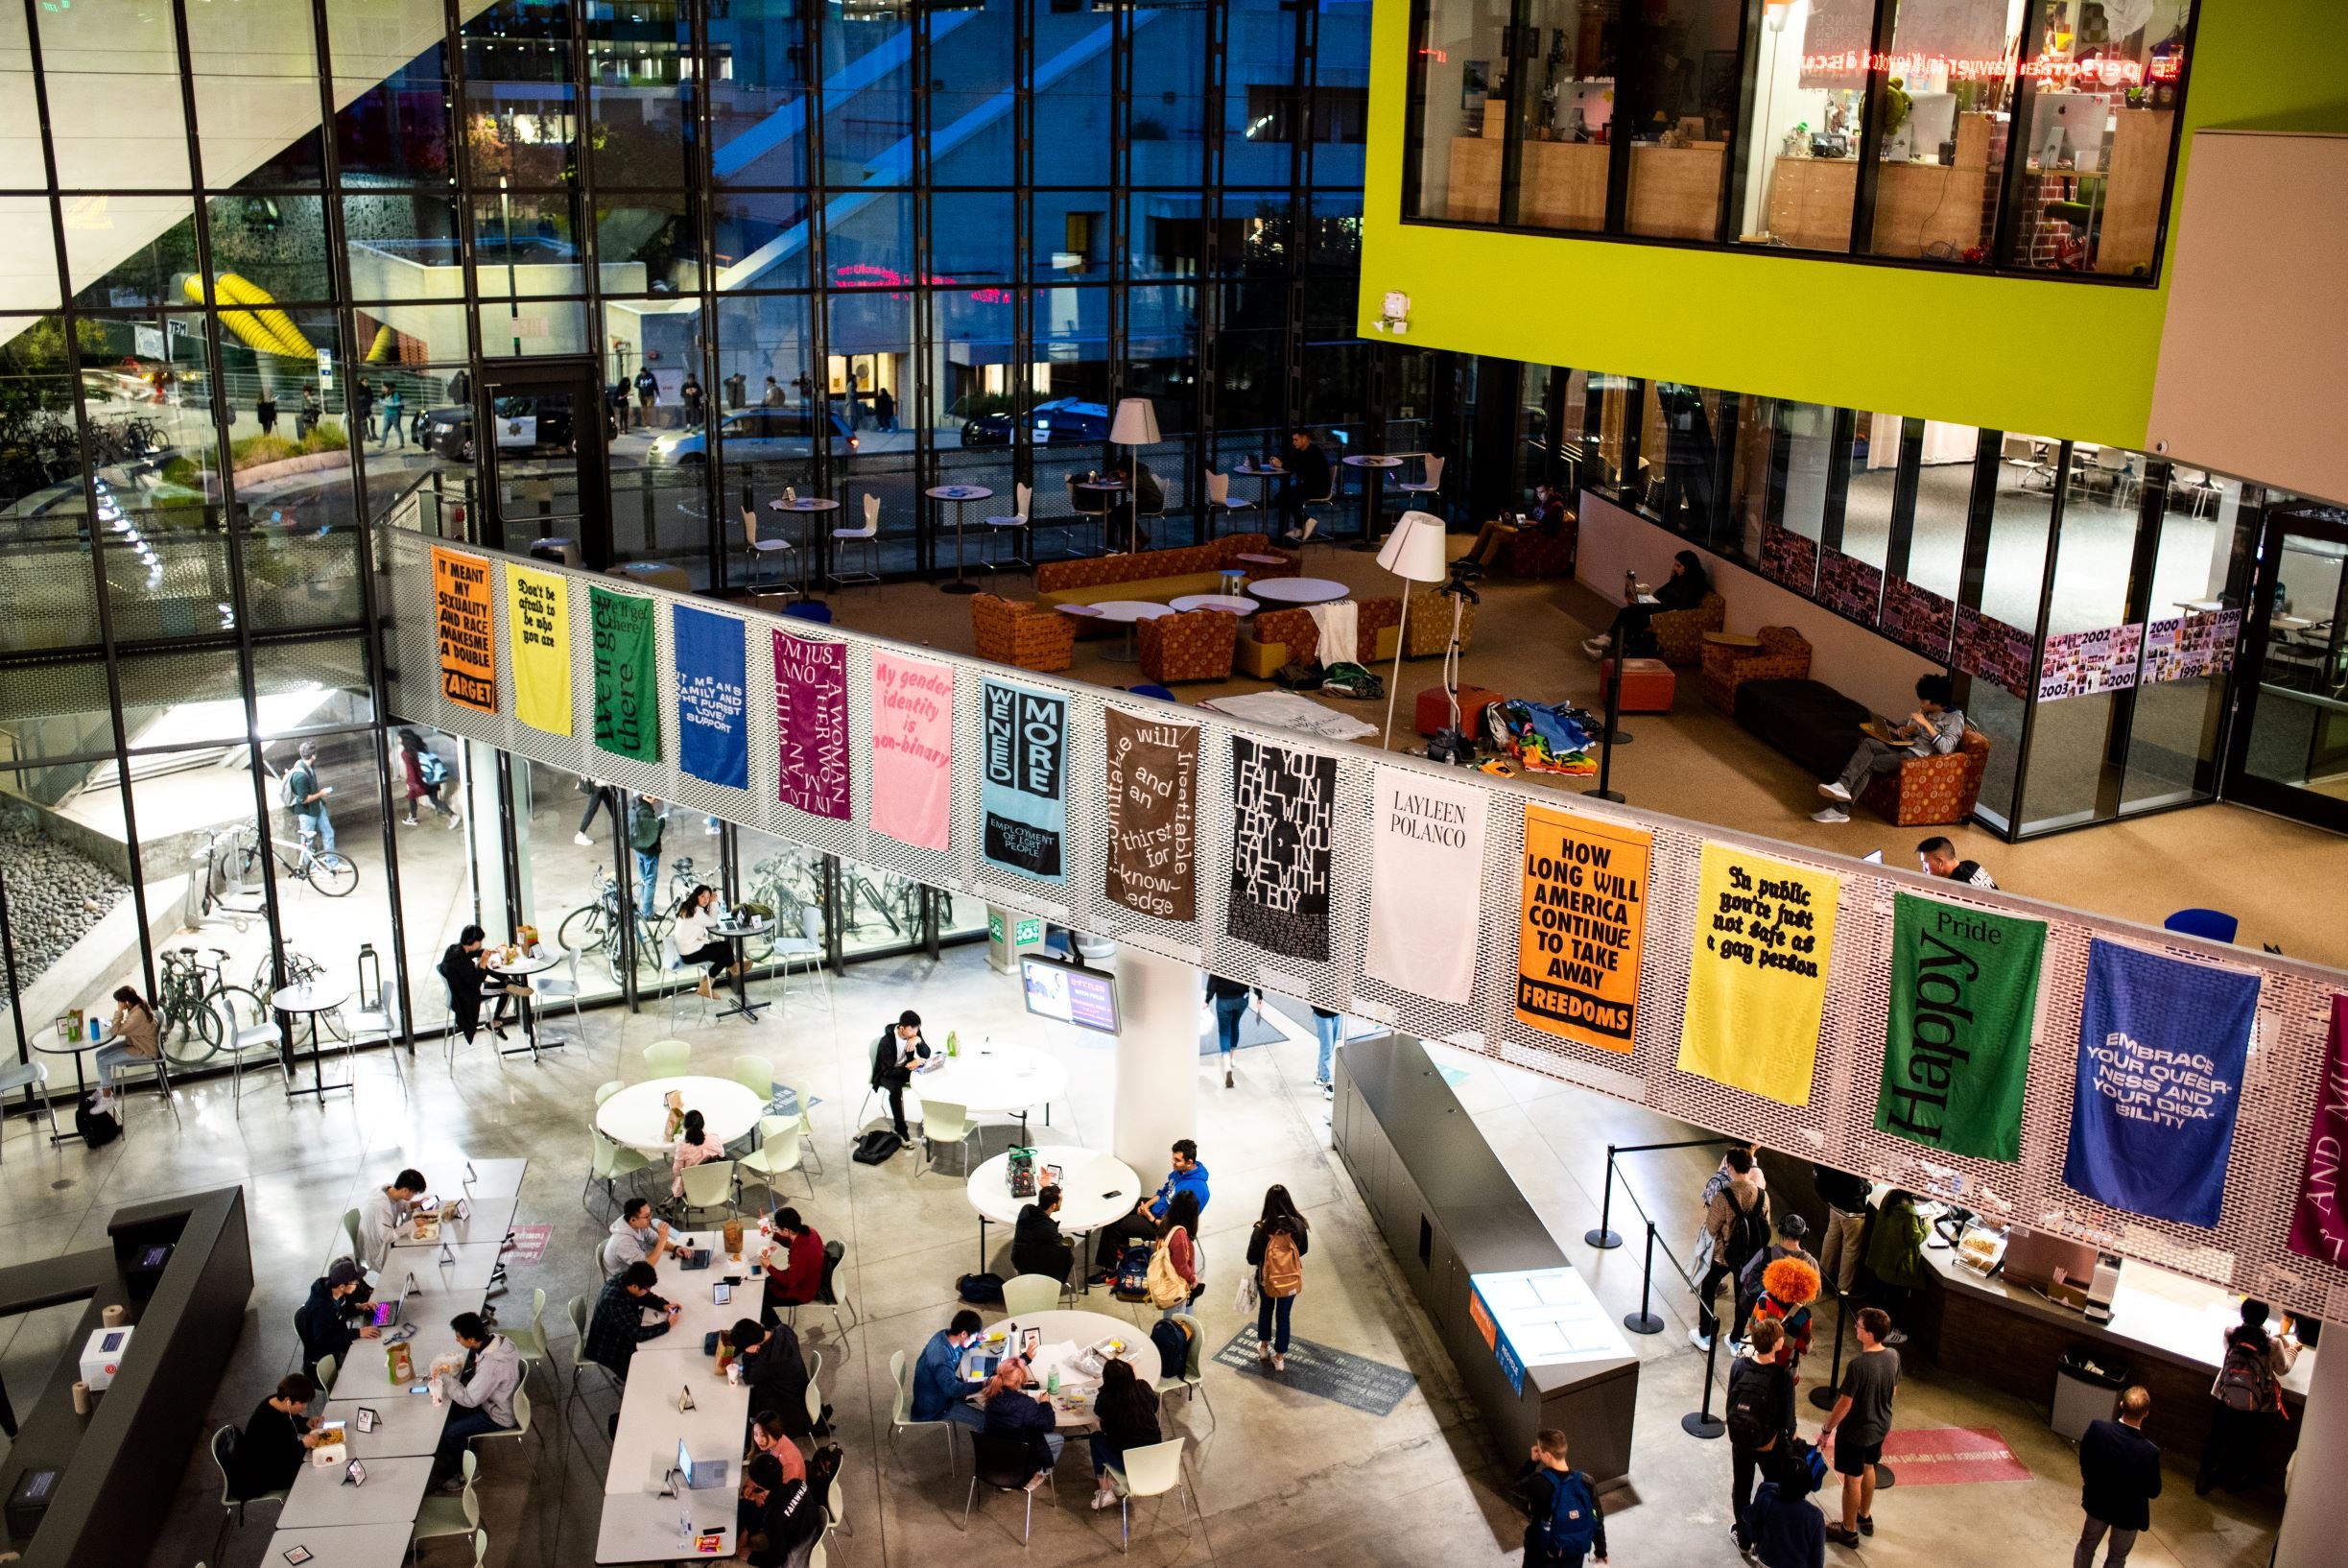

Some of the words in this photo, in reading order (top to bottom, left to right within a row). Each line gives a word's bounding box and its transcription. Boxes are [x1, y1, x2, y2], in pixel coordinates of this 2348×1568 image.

[439, 558, 446, 575] IT
[450, 562, 484, 584] MEANT
[454, 581, 470, 597] MY
[518, 579, 543, 596] Don't
[546, 586, 556, 601] be
[1911, 585, 1932, 601] 2008
[439, 591, 487, 619] SEXUALITY
[519, 599, 543, 614] afraid
[547, 605, 556, 617] to
[630, 606, 649, 622] get
[1840, 601, 1855, 615] 2011
[1959, 606, 1980, 624] 2006
[2218, 610, 2241, 623] 1998
[439, 608, 460, 628] AND
[463, 617, 488, 635] RACE
[524, 612, 534, 626] be
[536, 619, 553, 633] who
[1884, 622, 1904, 639] 2009
[2149, 620, 2179, 633] 2000
[523, 630, 539, 645] you
[541, 636, 555, 648] are
[2009, 630, 2033, 648] 2004
[2081, 630, 2110, 644] 2002
[441, 641, 450, 656] A
[454, 649, 490, 668] DOUBLE
[1928, 644, 1949, 659] 2007
[876, 662, 895, 686] My
[900, 671, 952, 697] gender
[1980, 667, 2001, 686] 2005
[2109, 673, 2134, 687] 2001
[2179, 665, 2203, 677] 1999
[695, 676, 743, 697] MEANS
[720, 693, 742, 706] AND
[828, 682, 842, 698] A
[2039, 683, 2069, 698] 2003
[618, 663, 641, 751] there
[677, 693, 698, 704] THE
[700, 699, 742, 716] PUREST
[883, 690, 940, 723] identity
[686, 713, 732, 734] SUPPORT
[903, 718, 915, 733] is
[1136, 726, 1180, 748] will
[829, 704, 845, 803] WOMAN
[873, 735, 950, 769] non-binary
[1024, 698, 1058, 793] MORE
[1281, 748, 1316, 778] YOU
[1135, 767, 1174, 797] and
[1129, 785, 1152, 809] an
[1235, 785, 1272, 819] OVE
[1394, 791, 1466, 824] LAYLEEN
[990, 818, 1055, 845] EMPLOYMENT
[1003, 831, 1017, 843] OF
[1019, 836, 1041, 850] LGBT
[1122, 822, 1174, 851] thirst
[1295, 823, 1331, 852] YOU
[1391, 814, 1466, 849] POLANCO
[1005, 841, 1039, 857] PEOPLE
[1146, 848, 1170, 868] for
[1562, 838, 1611, 868] HOW
[1528, 854, 1583, 887] LONG
[1594, 872, 1639, 903] WILL
[1728, 866, 1752, 891] In
[1758, 879, 1812, 907] public
[1247, 878, 1258, 903] A
[1268, 883, 1301, 914] BOY
[1533, 884, 1628, 925] AMERICA
[1719, 891, 1771, 919] you're
[1775, 903, 1814, 932] just
[1529, 905, 1631, 950] CONTINUE
[1713, 913, 1743, 934] not
[1748, 920, 1786, 949] safe
[1791, 934, 1815, 953] as
[1937, 911, 2003, 945] Pride
[1537, 931, 1563, 954] TO
[1572, 938, 1618, 971] TAKE
[1707, 934, 1715, 951] a
[1720, 938, 1753, 965] gay
[1758, 948, 1818, 978] person
[1547, 958, 1604, 990] AWAY
[1522, 985, 1629, 1032] FREEDOMS
[1886, 927, 1980, 1144] Happy
[2105, 1031, 2215, 1077] EMBRACE
[2086, 1045, 2145, 1076] YOUR
[2148, 1062, 2233, 1095] QUEER-
[2092, 1076, 2153, 1106] YOUR
[2156, 1096, 2216, 1120] DISA-
[2099, 1064, 2162, 1093] NESS
[2165, 1083, 2214, 1106] AND
[2115, 1102, 2185, 1130] BILITY
[2306, 1135, 2341, 1216] AND
